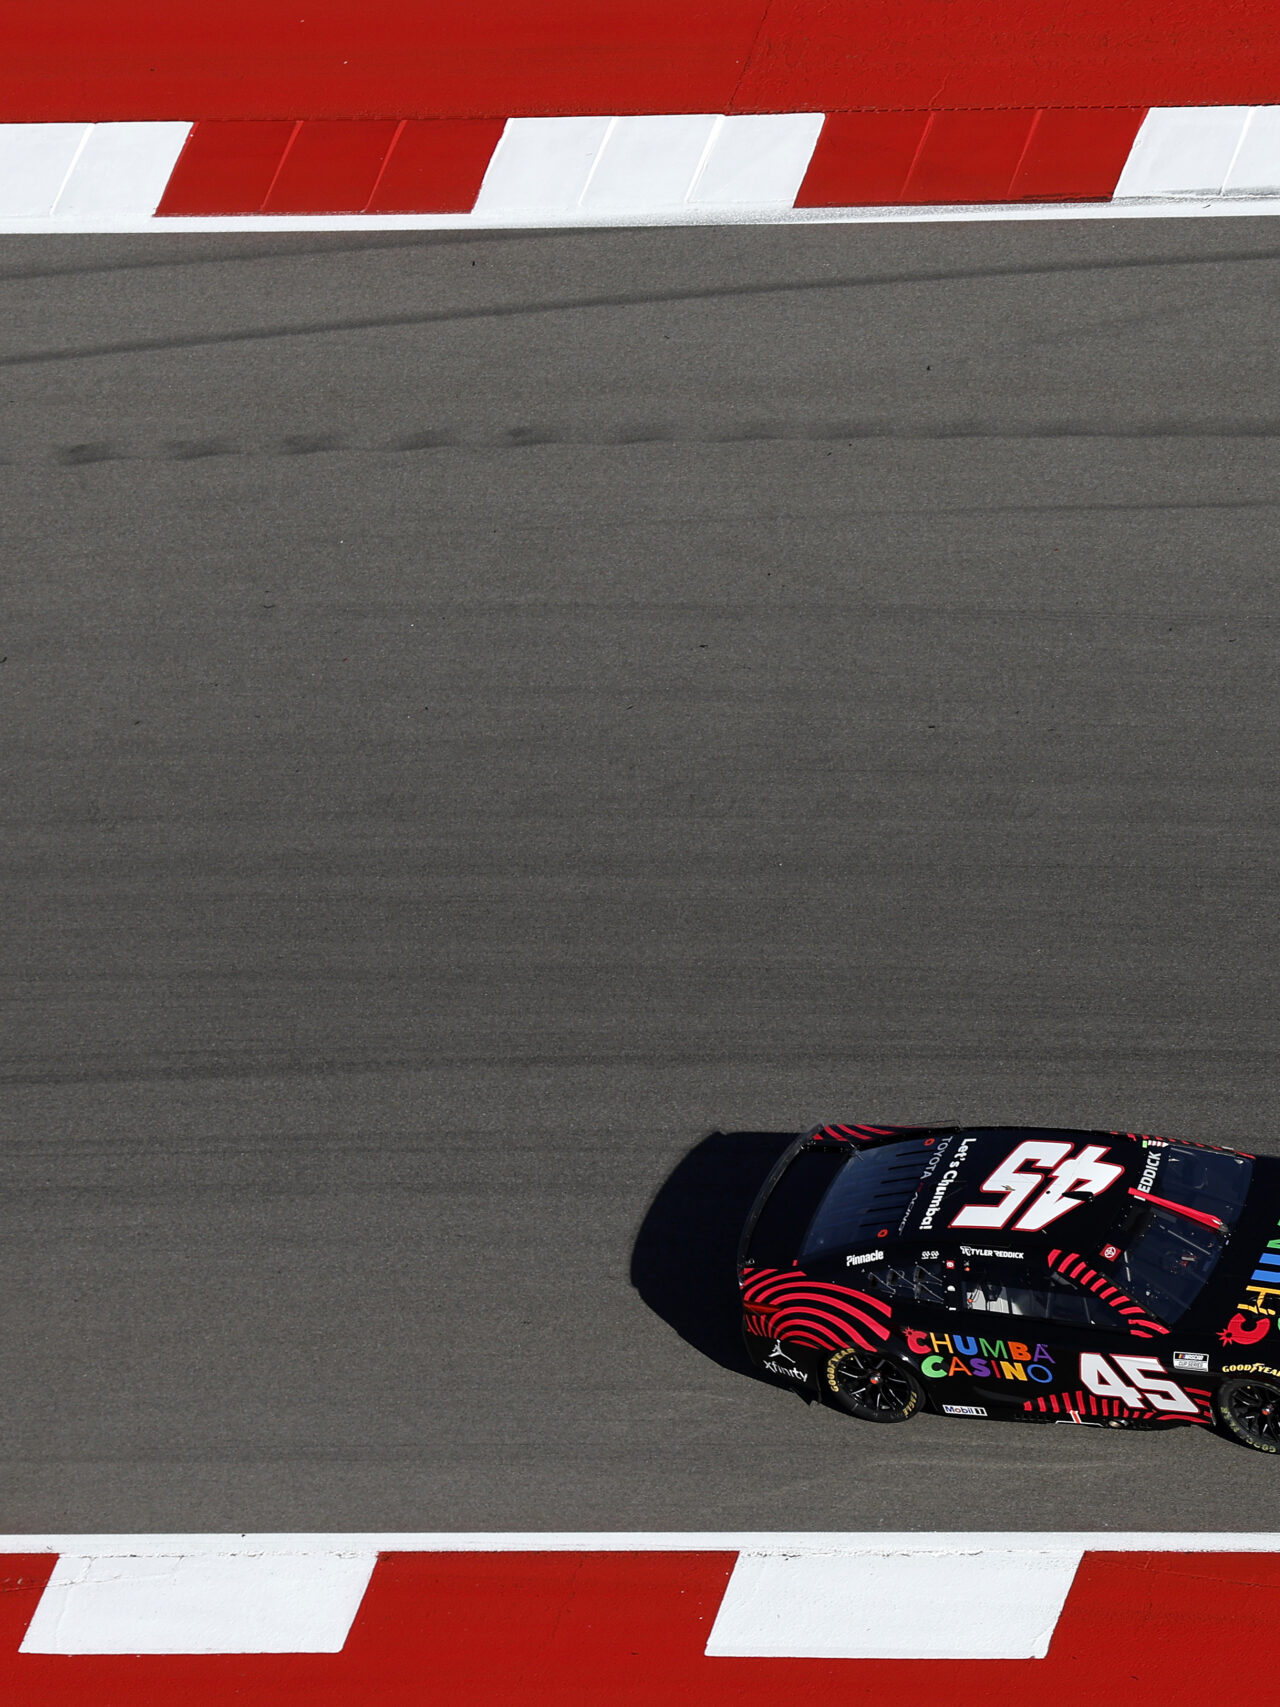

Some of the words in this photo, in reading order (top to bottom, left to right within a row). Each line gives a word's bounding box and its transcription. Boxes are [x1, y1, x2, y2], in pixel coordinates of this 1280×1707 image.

[920, 1135, 953, 1180] TOYOTA
[949, 1138, 977, 1168] Let's
[947, 1139, 1126, 1233] 45
[1133, 1151, 1162, 1202] EDDICK
[919, 1170, 958, 1230] Chumba!
[846, 1250, 884, 1267] Pinnacle
[971, 1249, 993, 1257] TYLER
[993, 1250, 1025, 1259] REDDICK
[904, 1327, 1056, 1365] CHUMBA
[763, 1360, 808, 1382] xfinity
[826, 1347, 856, 1393] GOODYEAR
[921, 1355, 1053, 1383] CASINO
[1079, 1352, 1200, 1414] 45
[945, 1405, 974, 1414] Mobil
